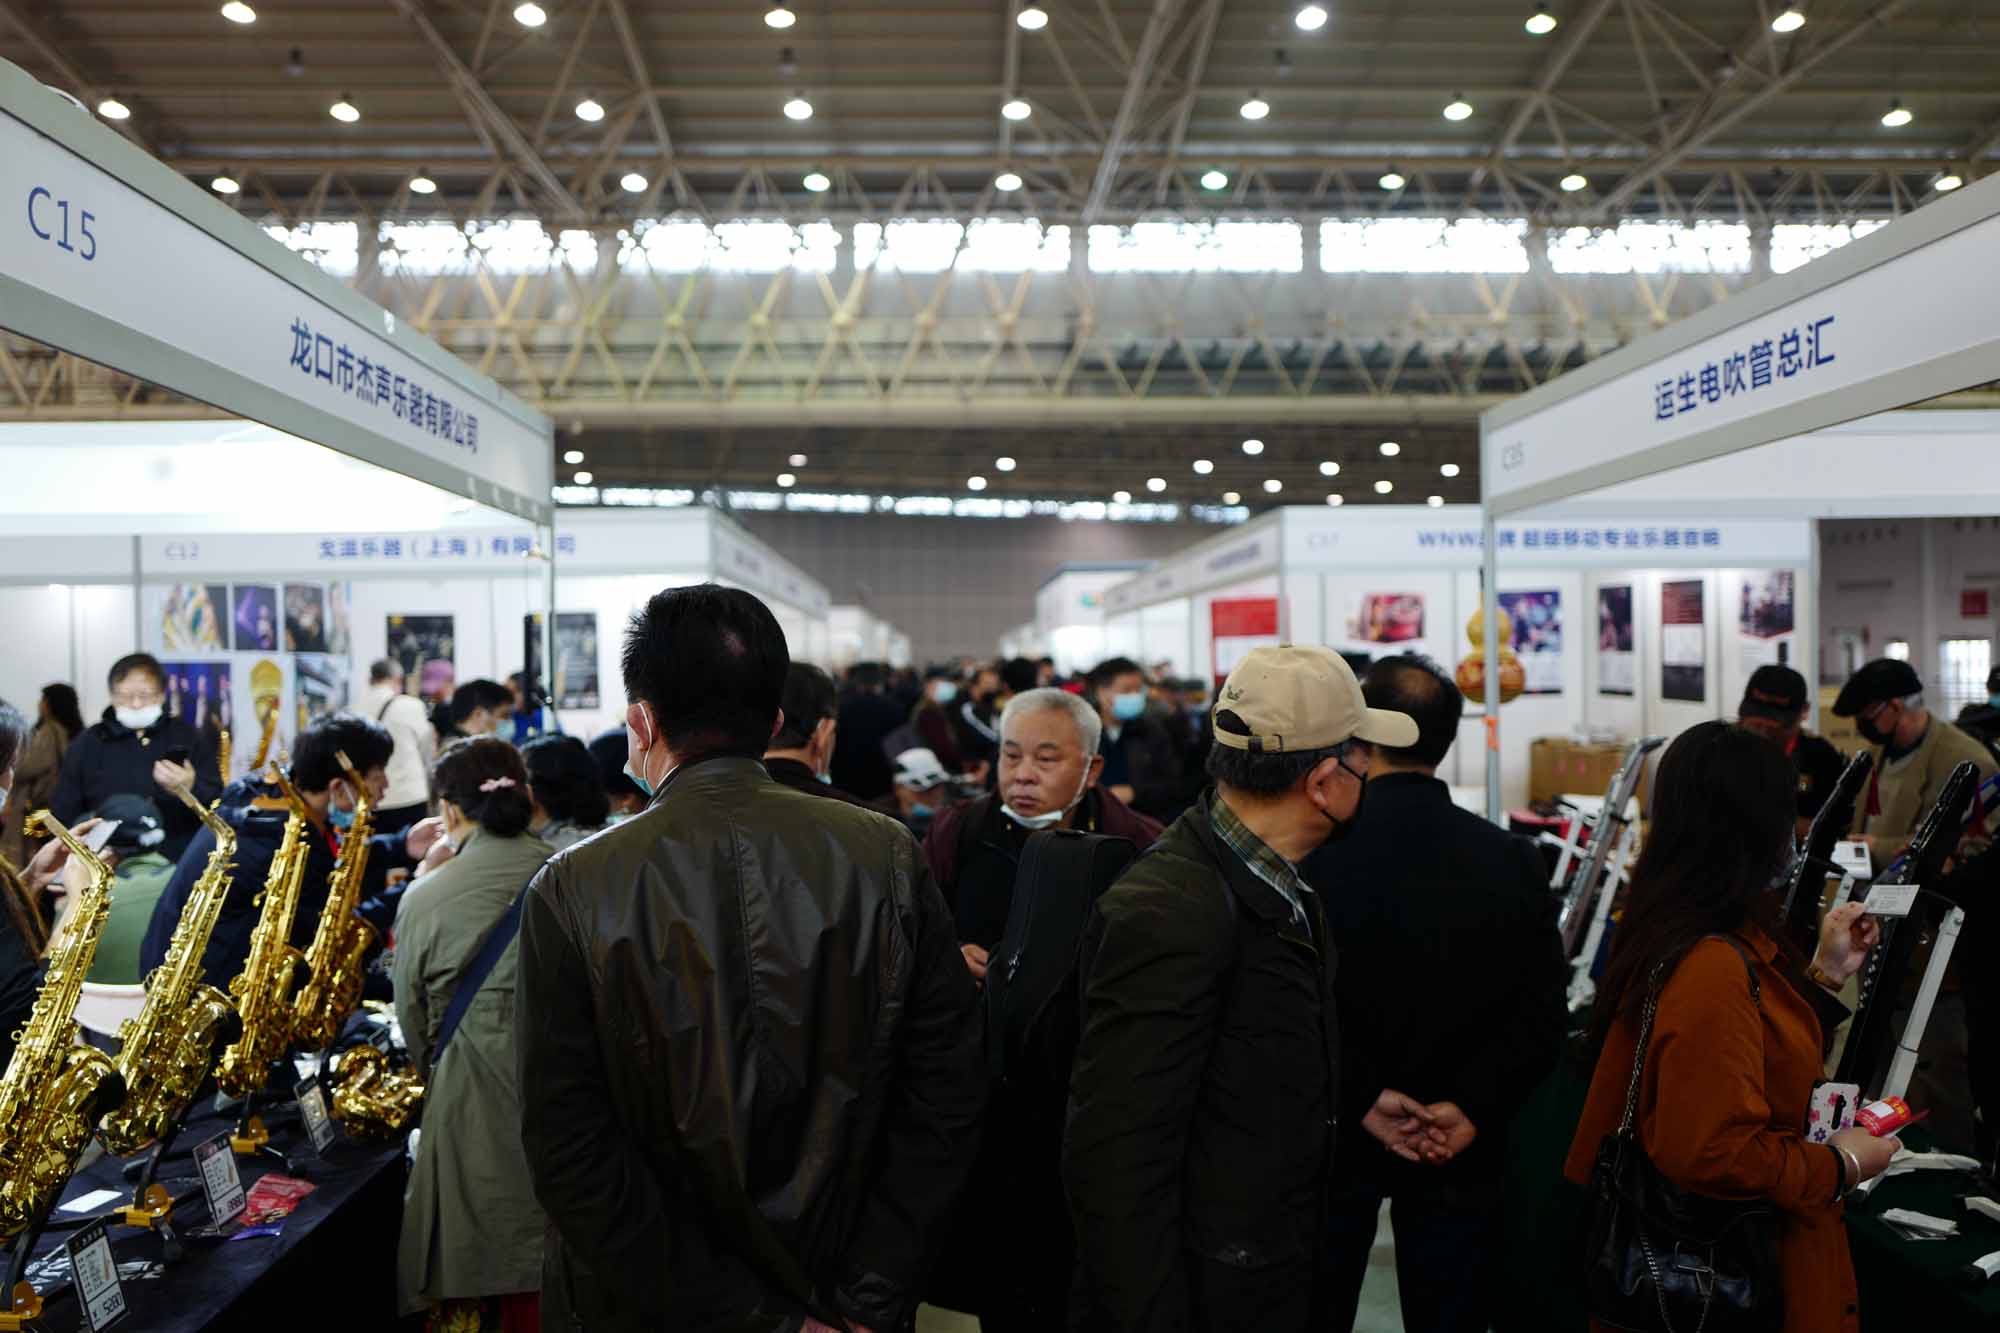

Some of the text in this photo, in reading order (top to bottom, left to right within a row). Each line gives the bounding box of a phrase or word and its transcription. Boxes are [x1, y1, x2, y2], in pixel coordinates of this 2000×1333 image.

[27, 186, 97, 261] C15
[289, 316, 479, 454] 龙口市杰声乐器有限公司
[1654, 315, 1837, 421] 运生电吹管总汇
